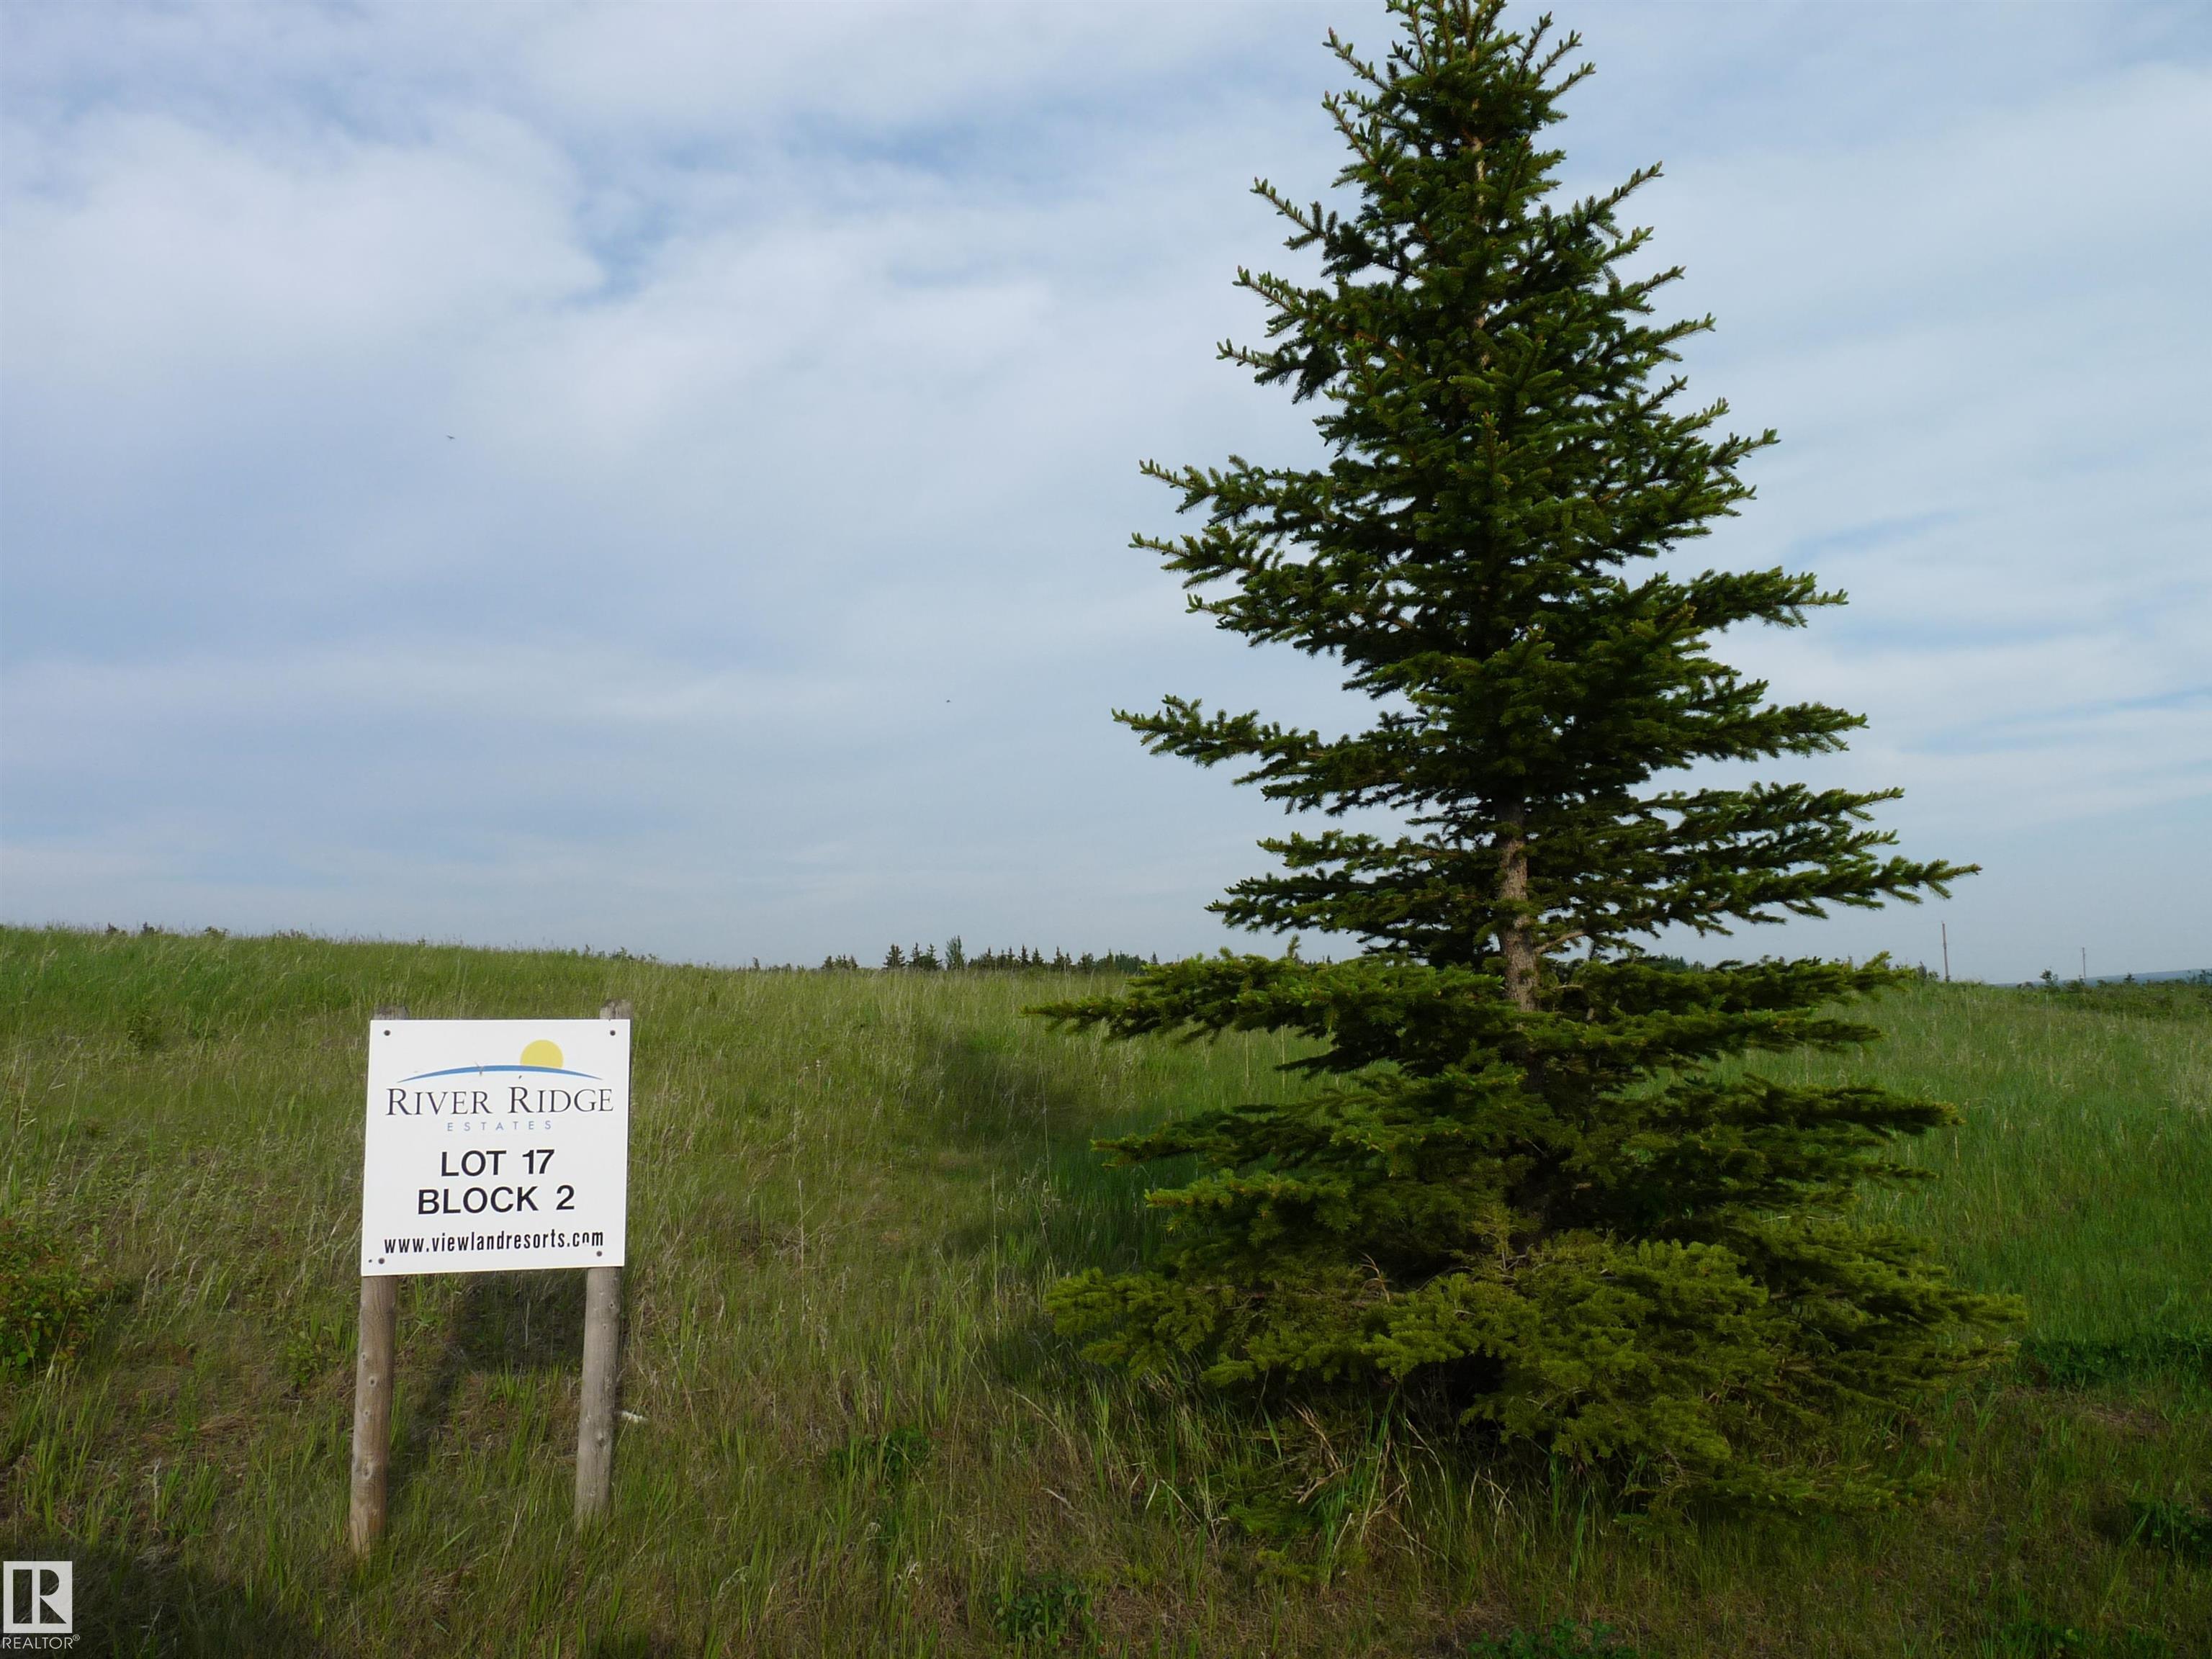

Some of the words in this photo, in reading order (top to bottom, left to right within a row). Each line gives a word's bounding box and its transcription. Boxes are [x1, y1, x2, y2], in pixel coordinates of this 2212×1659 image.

[386, 1088, 494, 1116] RIVER
[508, 1086, 614, 1113] RIDGE
[446, 1120, 552, 1132] ESTATES
[441, 1150, 507, 1177] LOT
[522, 1149, 554, 1174] 17
[418, 1187, 539, 1215] BLOCK
[556, 1184, 575, 1210] 2
[384, 1228, 603, 1254] www.viewlandresorts.com
